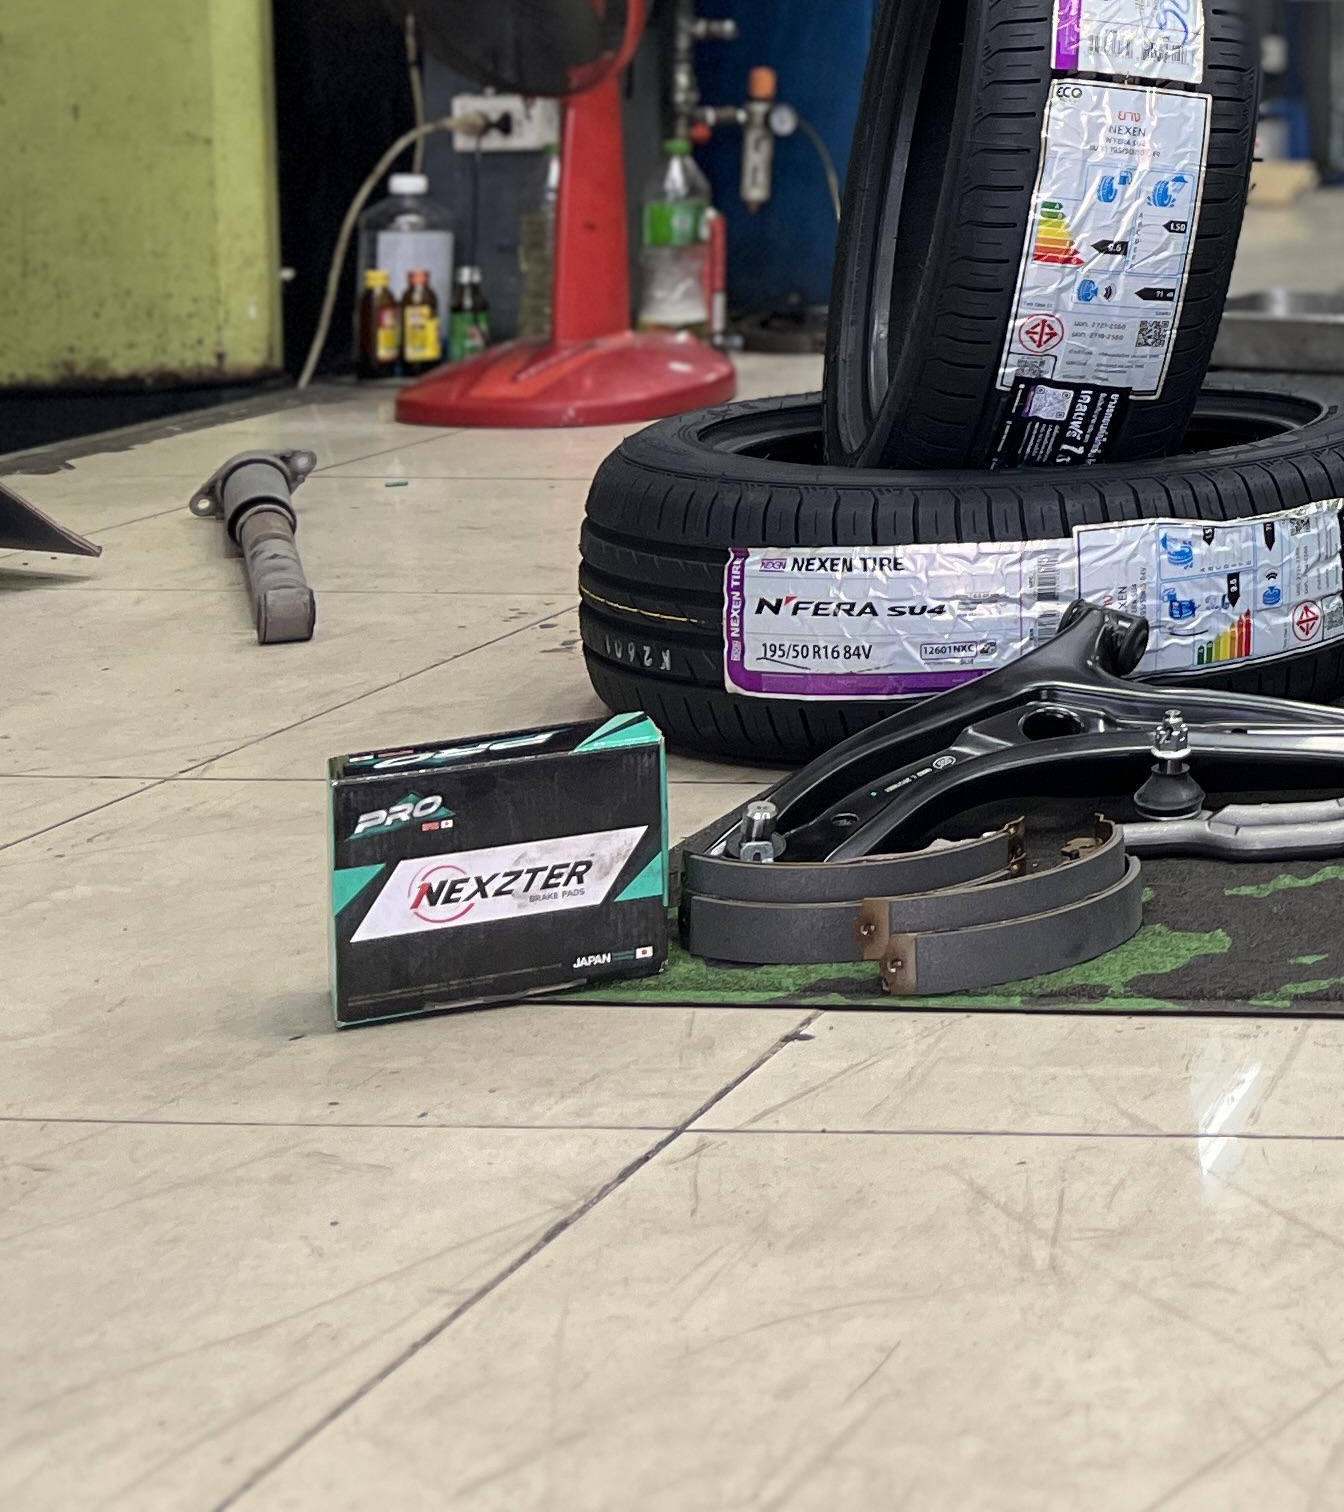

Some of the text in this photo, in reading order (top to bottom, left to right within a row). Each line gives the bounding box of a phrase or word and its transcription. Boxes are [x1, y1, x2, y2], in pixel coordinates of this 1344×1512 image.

[1056, 86, 1083, 99] ECO
[1117, 110, 1141, 123] ยาง
[1108, 125, 1146, 138] NEXEN
[791, 557, 853, 573] NEXEN
[860, 557, 905, 572] TIRE
[730, 591, 741, 638] NEXEN
[755, 596, 946, 617] N'FERA SU4
[762, 643, 873, 660] 195/50 R16 84V
[923, 643, 975, 656] 12601NXC
[354, 795, 442, 835] PRO
[410, 860, 592, 909] NEXZTER
[529, 888, 585, 903] BRAKE PADS
[573, 952, 612, 968] JAPAN
